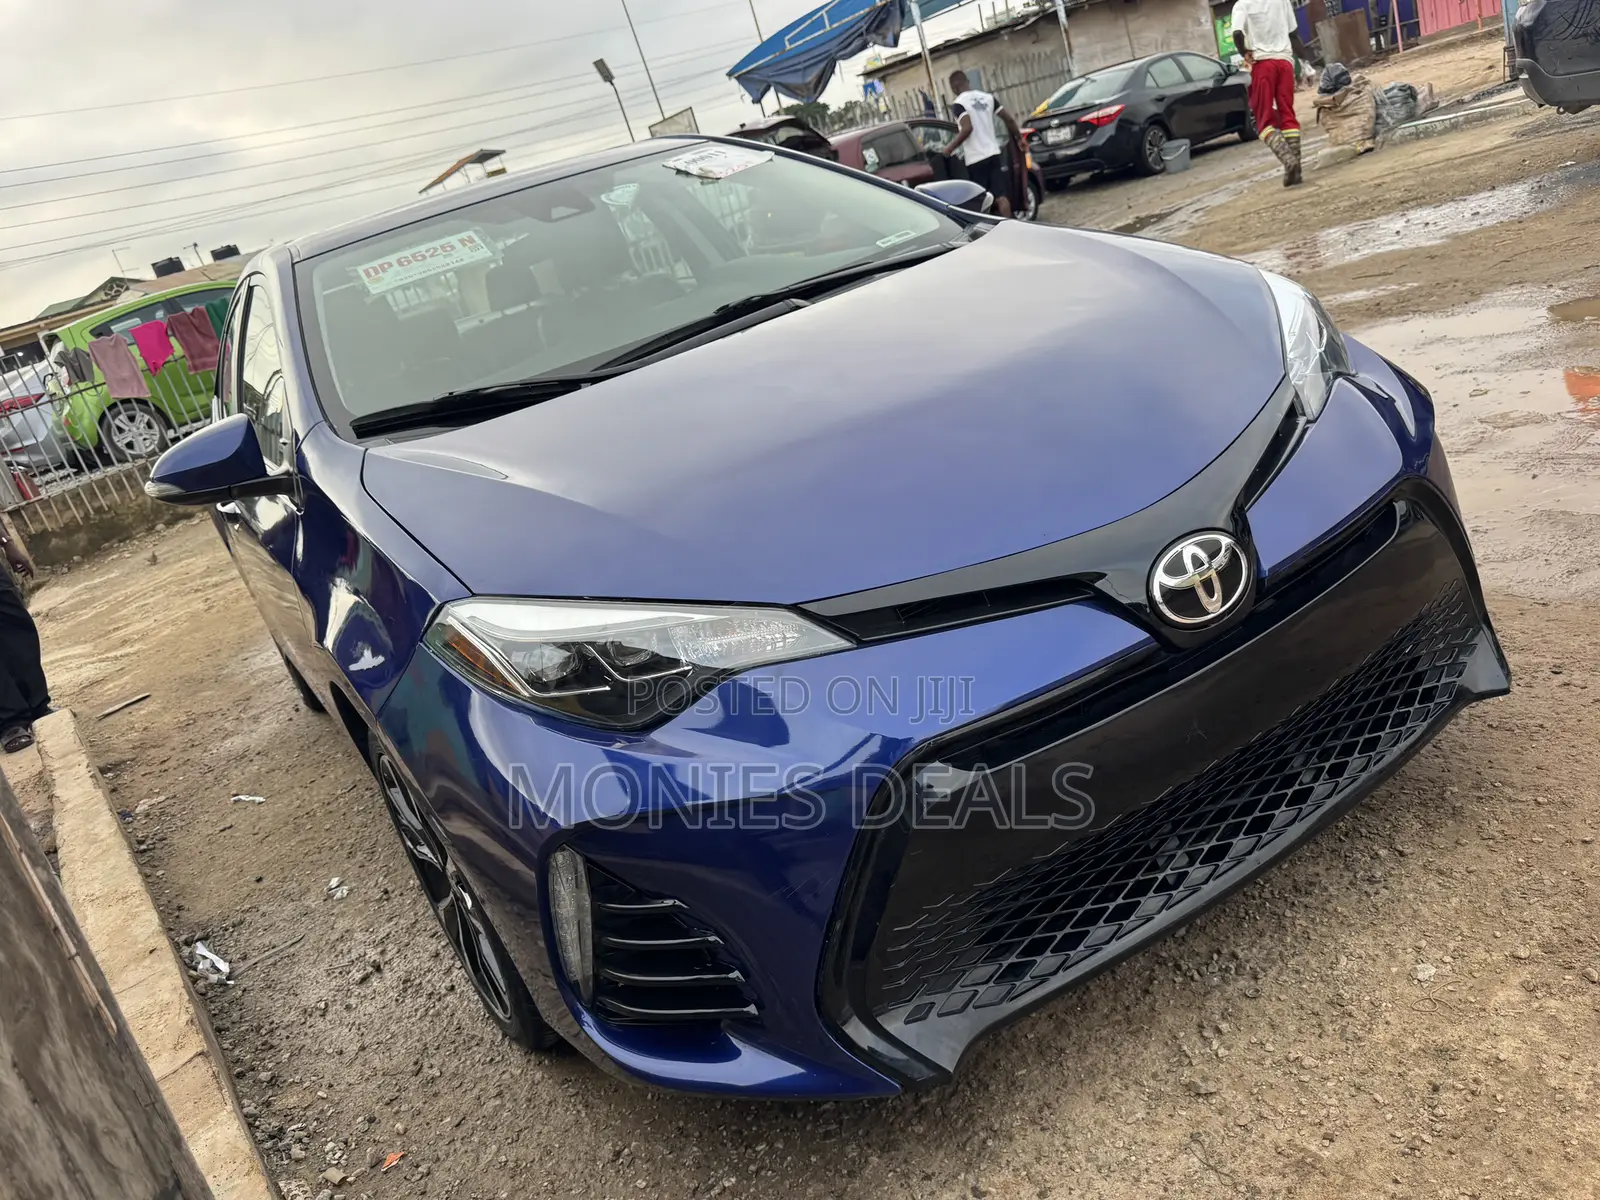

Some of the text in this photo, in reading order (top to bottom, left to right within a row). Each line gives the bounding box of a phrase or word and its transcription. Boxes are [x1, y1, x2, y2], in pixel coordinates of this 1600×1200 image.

[363, 261, 394, 278] DP
[396, 242, 456, 267] 6525
[458, 235, 477, 248] N
